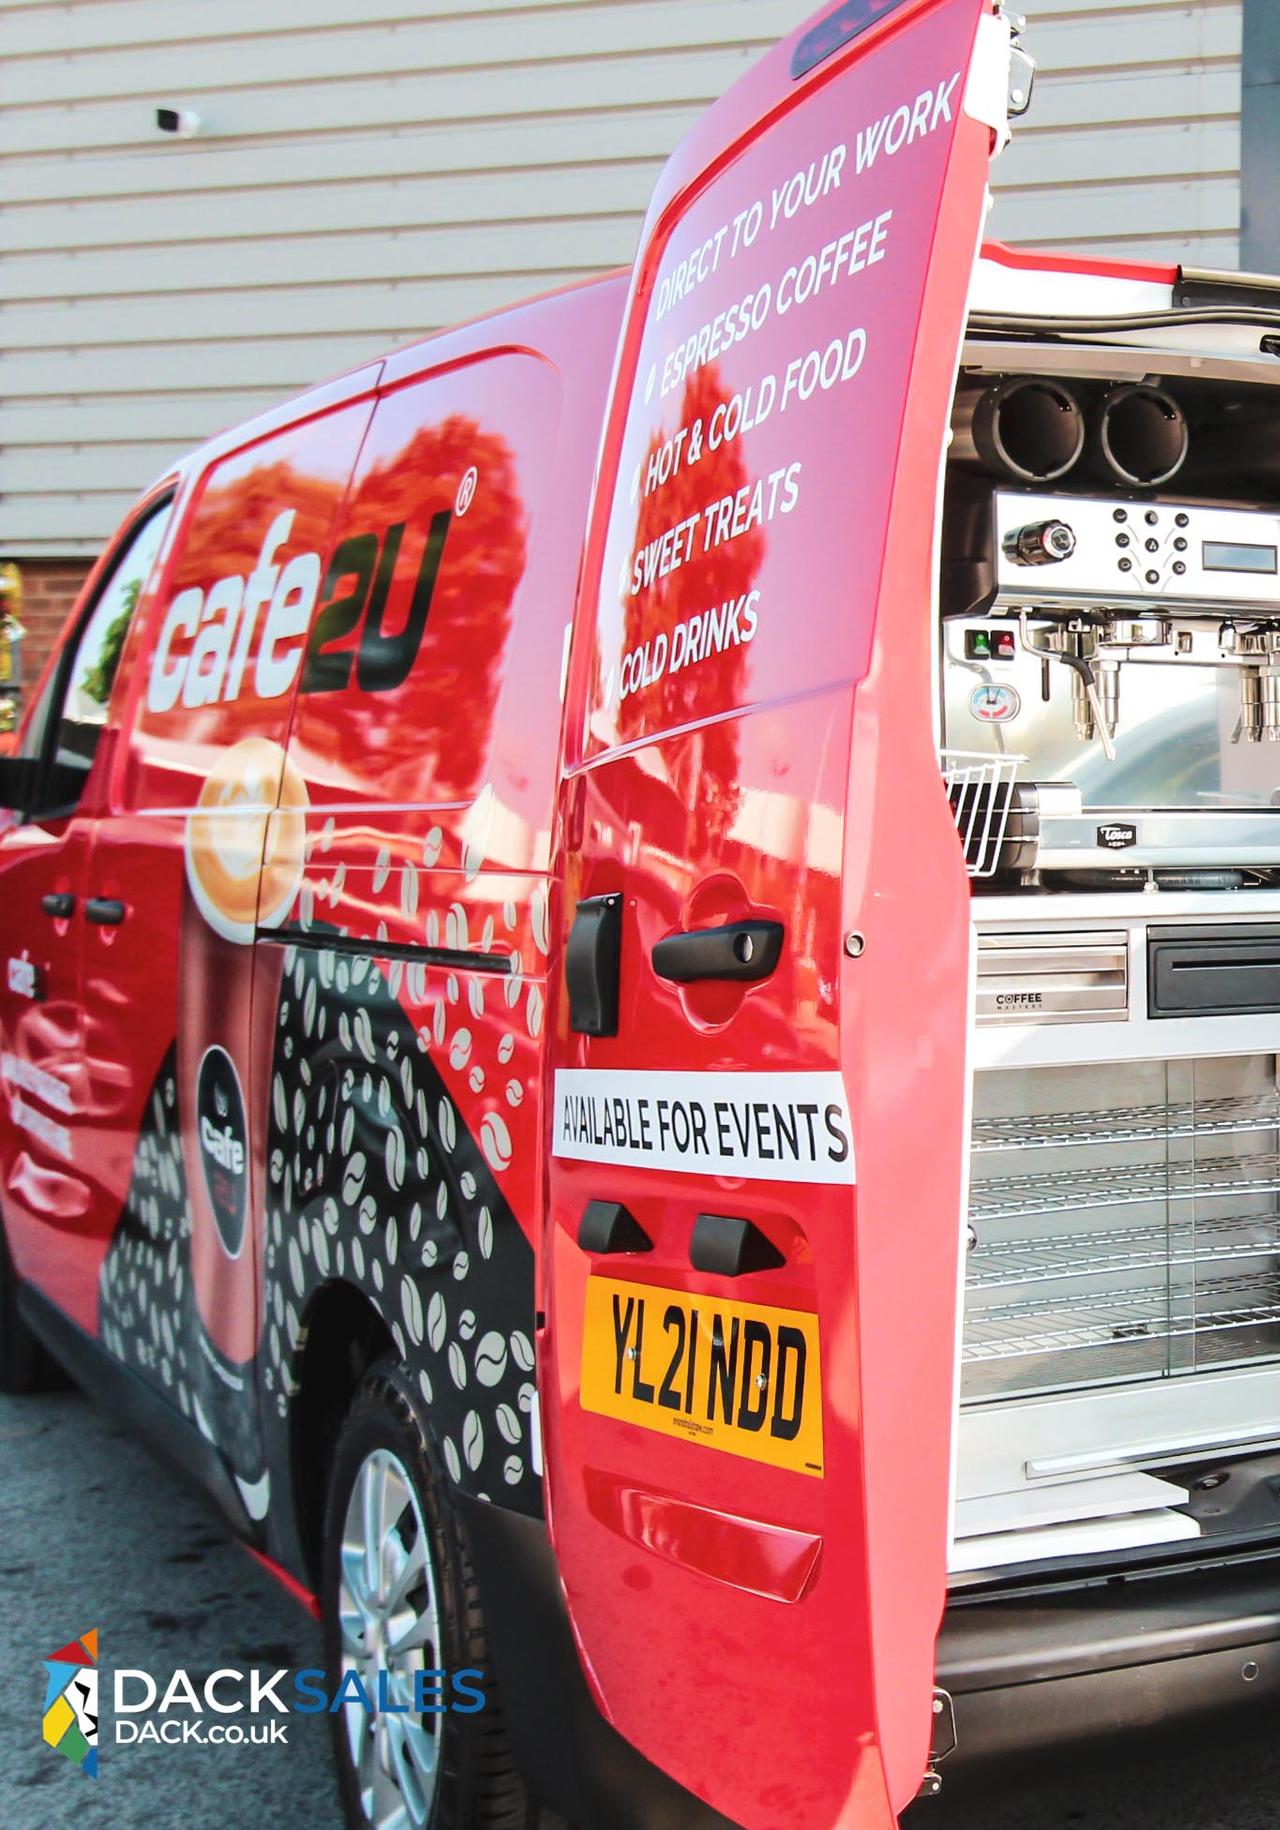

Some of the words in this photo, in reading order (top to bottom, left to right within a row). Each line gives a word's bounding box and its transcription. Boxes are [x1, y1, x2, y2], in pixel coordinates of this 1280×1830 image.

[656, 225, 729, 321] DIRECT
[731, 201, 763, 258] TO
[770, 144, 847, 230] YOUR
[856, 72, 961, 175] WORK
[660, 283, 771, 398] ESPRESSO
[776, 209, 893, 315] COFFEE
[644, 428, 688, 498] HOT
[687, 418, 703, 466] &
[708, 375, 776, 451] COLD
[780, 328, 866, 412] FOOD
[631, 512, 702, 597] SWEET
[704, 462, 802, 552] TREATS
[618, 633, 668, 701] COLD
[669, 590, 761, 675] DRINKS
[996, 992, 1042, 1004] COFFEE
[563, 1095, 653, 1150] AVAILABLE
[657, 1100, 709, 1156] FOR
[713, 1102, 849, 1163] EVENTS
[612, 1293, 699, 1414] YL21
[706, 1313, 807, 1442] NDD
